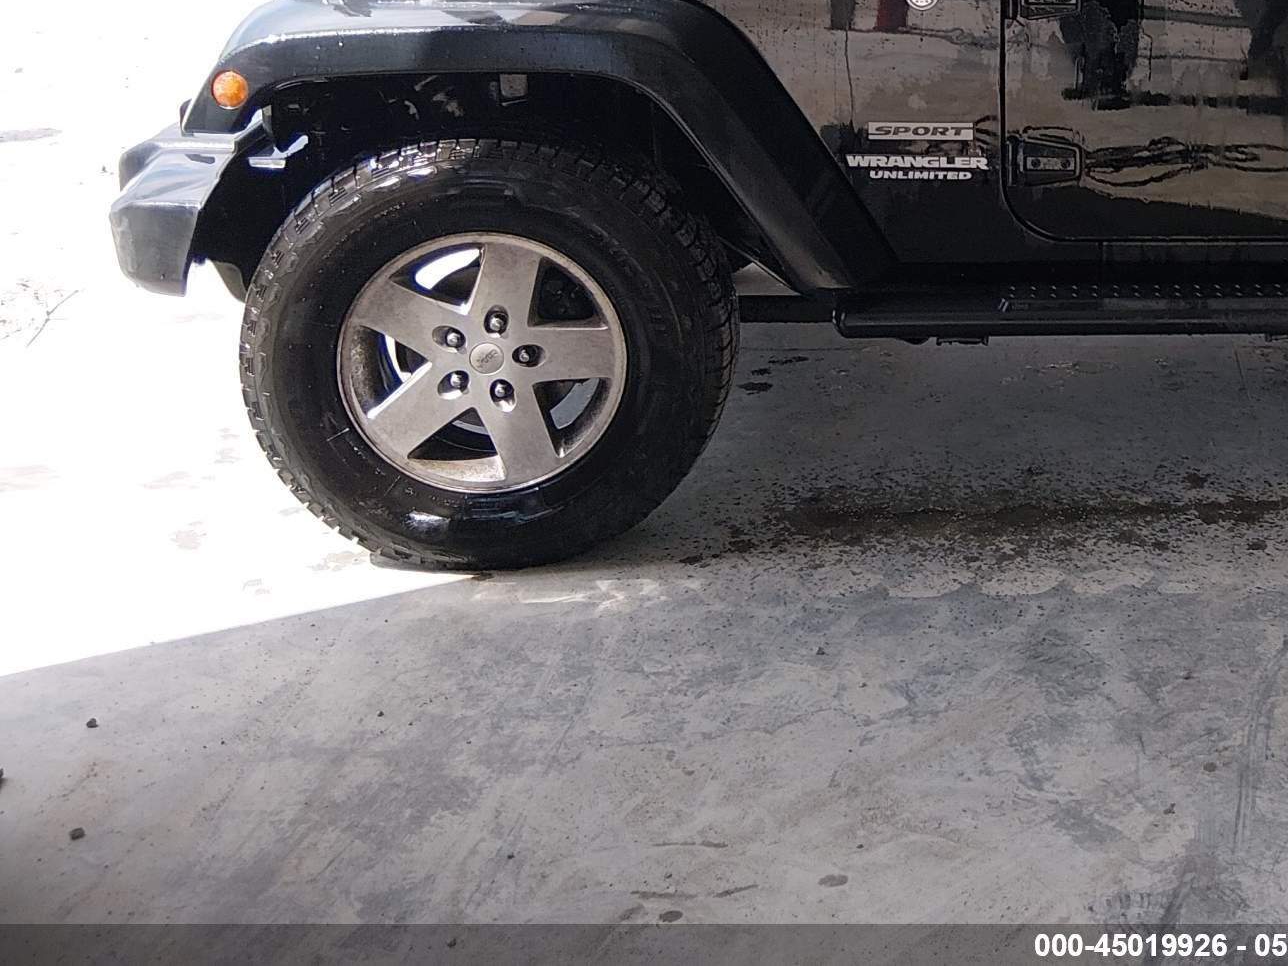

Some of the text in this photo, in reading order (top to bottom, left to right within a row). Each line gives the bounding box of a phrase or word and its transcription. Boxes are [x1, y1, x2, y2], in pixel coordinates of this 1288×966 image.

[870, 125, 972, 137] SPORT
[846, 154, 989, 170] WRANGLER
[869, 169, 972, 180] UNLIMITED
